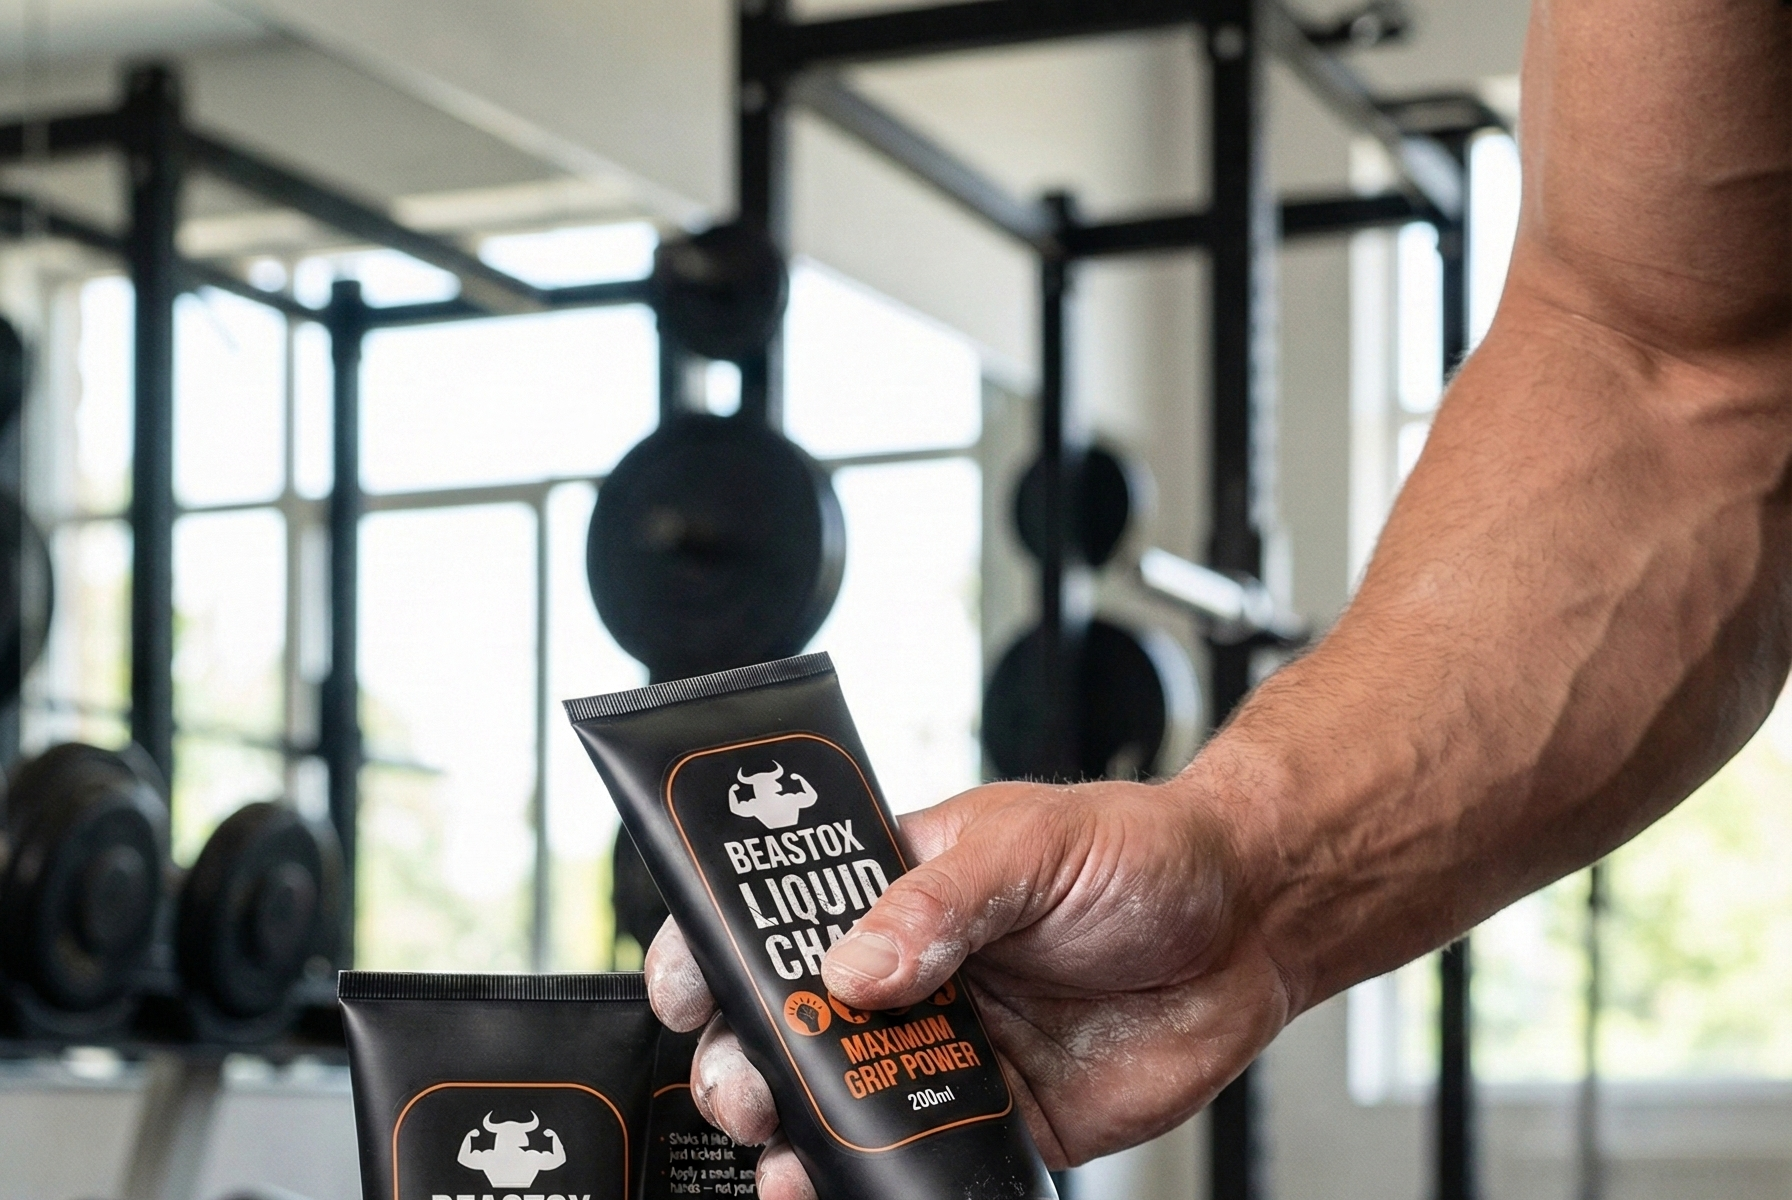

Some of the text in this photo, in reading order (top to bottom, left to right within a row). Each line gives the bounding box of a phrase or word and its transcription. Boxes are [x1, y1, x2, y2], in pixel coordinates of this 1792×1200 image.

[723, 819, 865, 875] BEASTOX
[738, 858, 889, 930] LIQUID
[840, 1014, 957, 1065] MAXIMUM
[843, 1040, 981, 1099] GRIP POWER
[908, 1085, 955, 1111] 200ml
